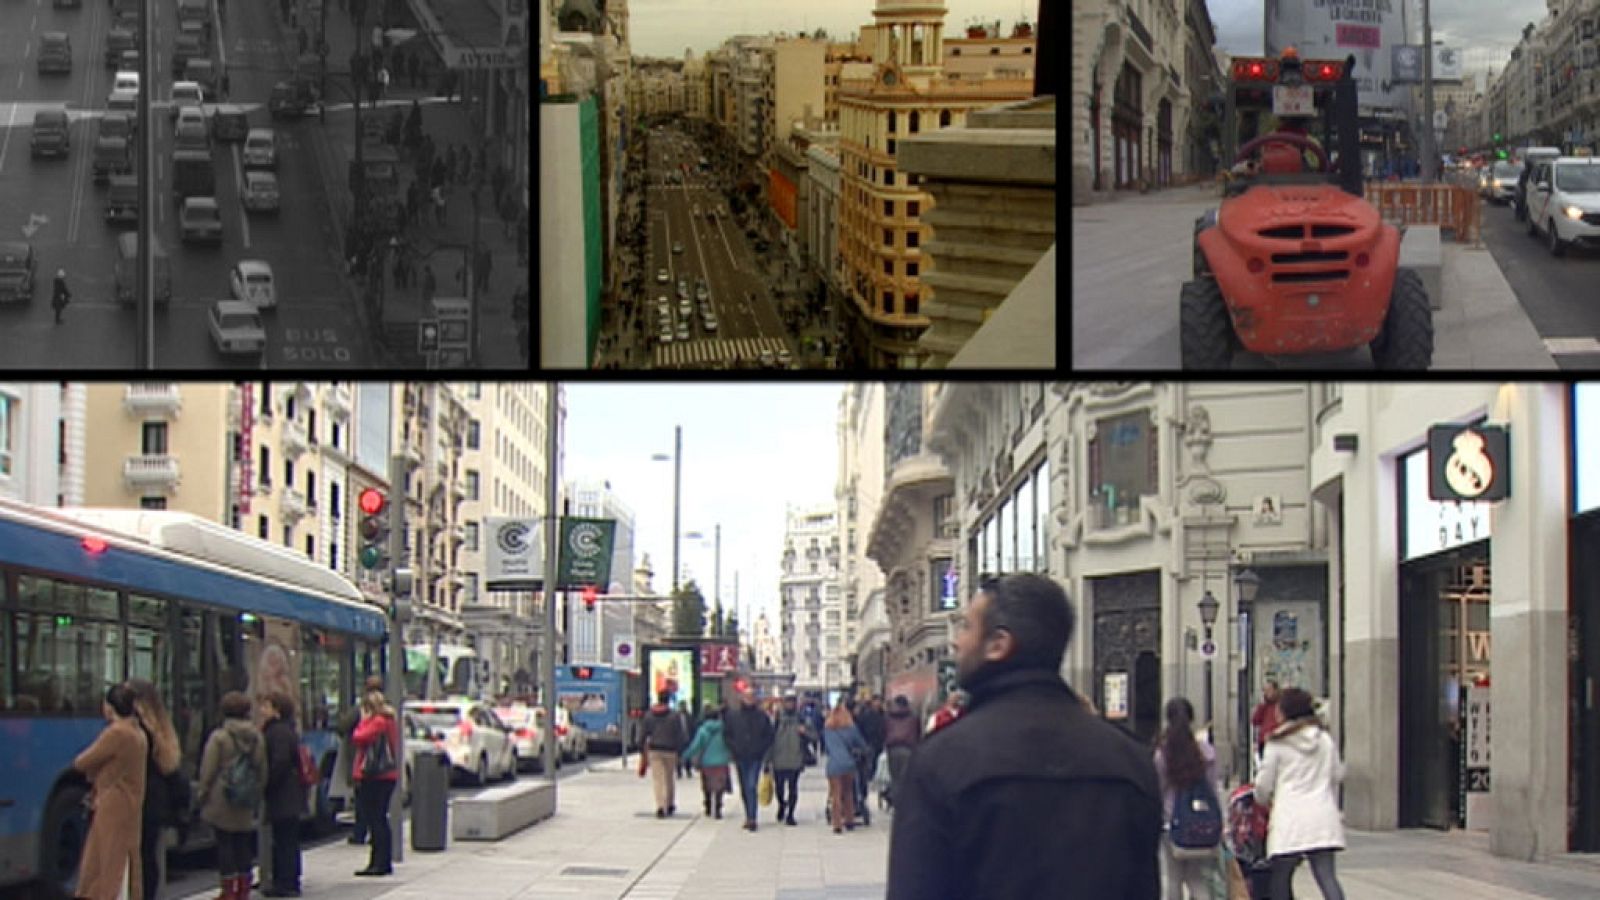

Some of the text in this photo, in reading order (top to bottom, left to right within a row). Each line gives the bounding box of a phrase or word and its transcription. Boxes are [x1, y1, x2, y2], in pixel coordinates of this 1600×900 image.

[285, 328, 338, 343] BUS
[282, 346, 351, 362] SOLO
[1439, 516, 1480, 546] DAY
